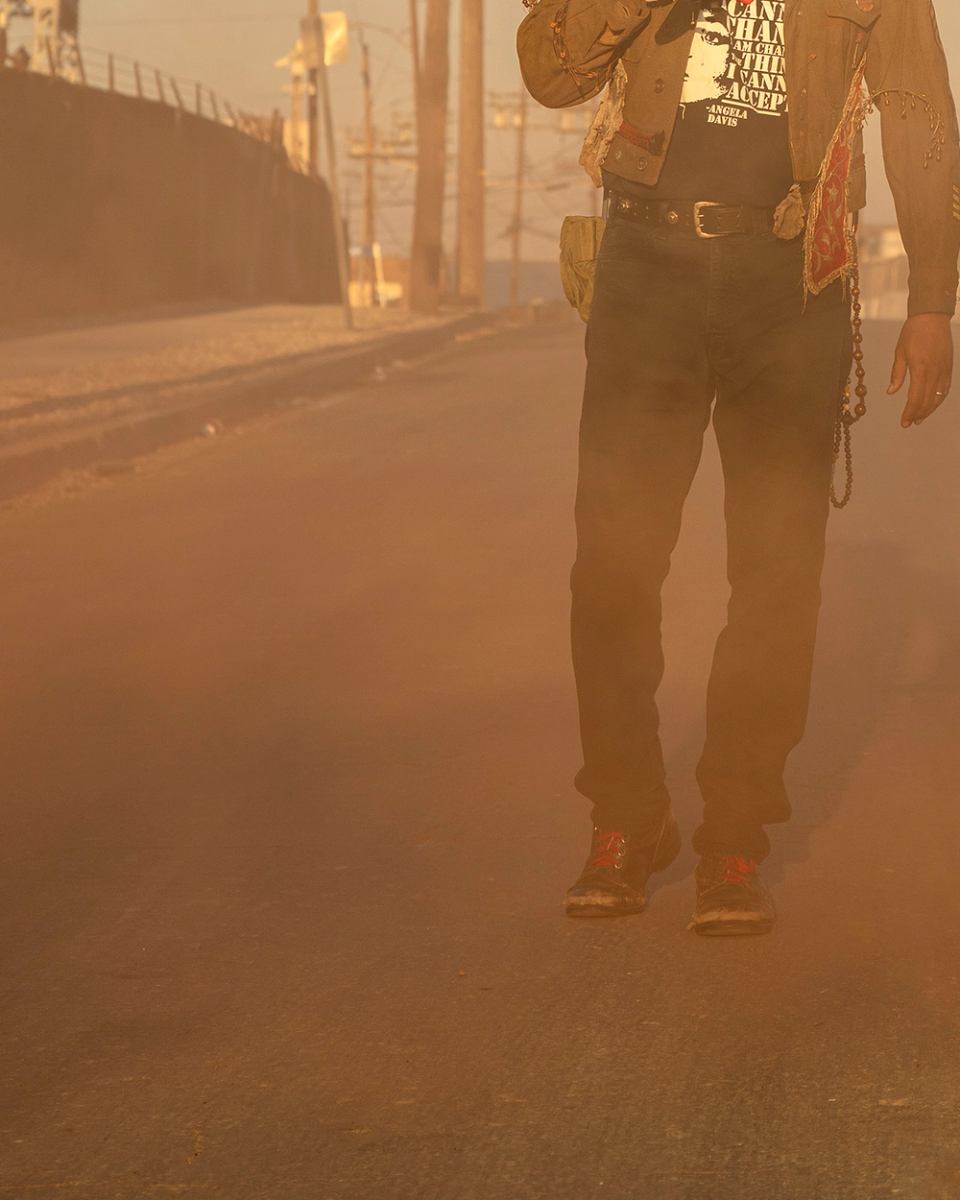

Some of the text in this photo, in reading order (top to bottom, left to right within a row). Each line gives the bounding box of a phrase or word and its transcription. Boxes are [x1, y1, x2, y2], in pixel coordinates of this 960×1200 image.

[733, 40, 753, 53] AM
[727, 62, 736, 79] I
[707, 114, 738, 127] DAVIS
